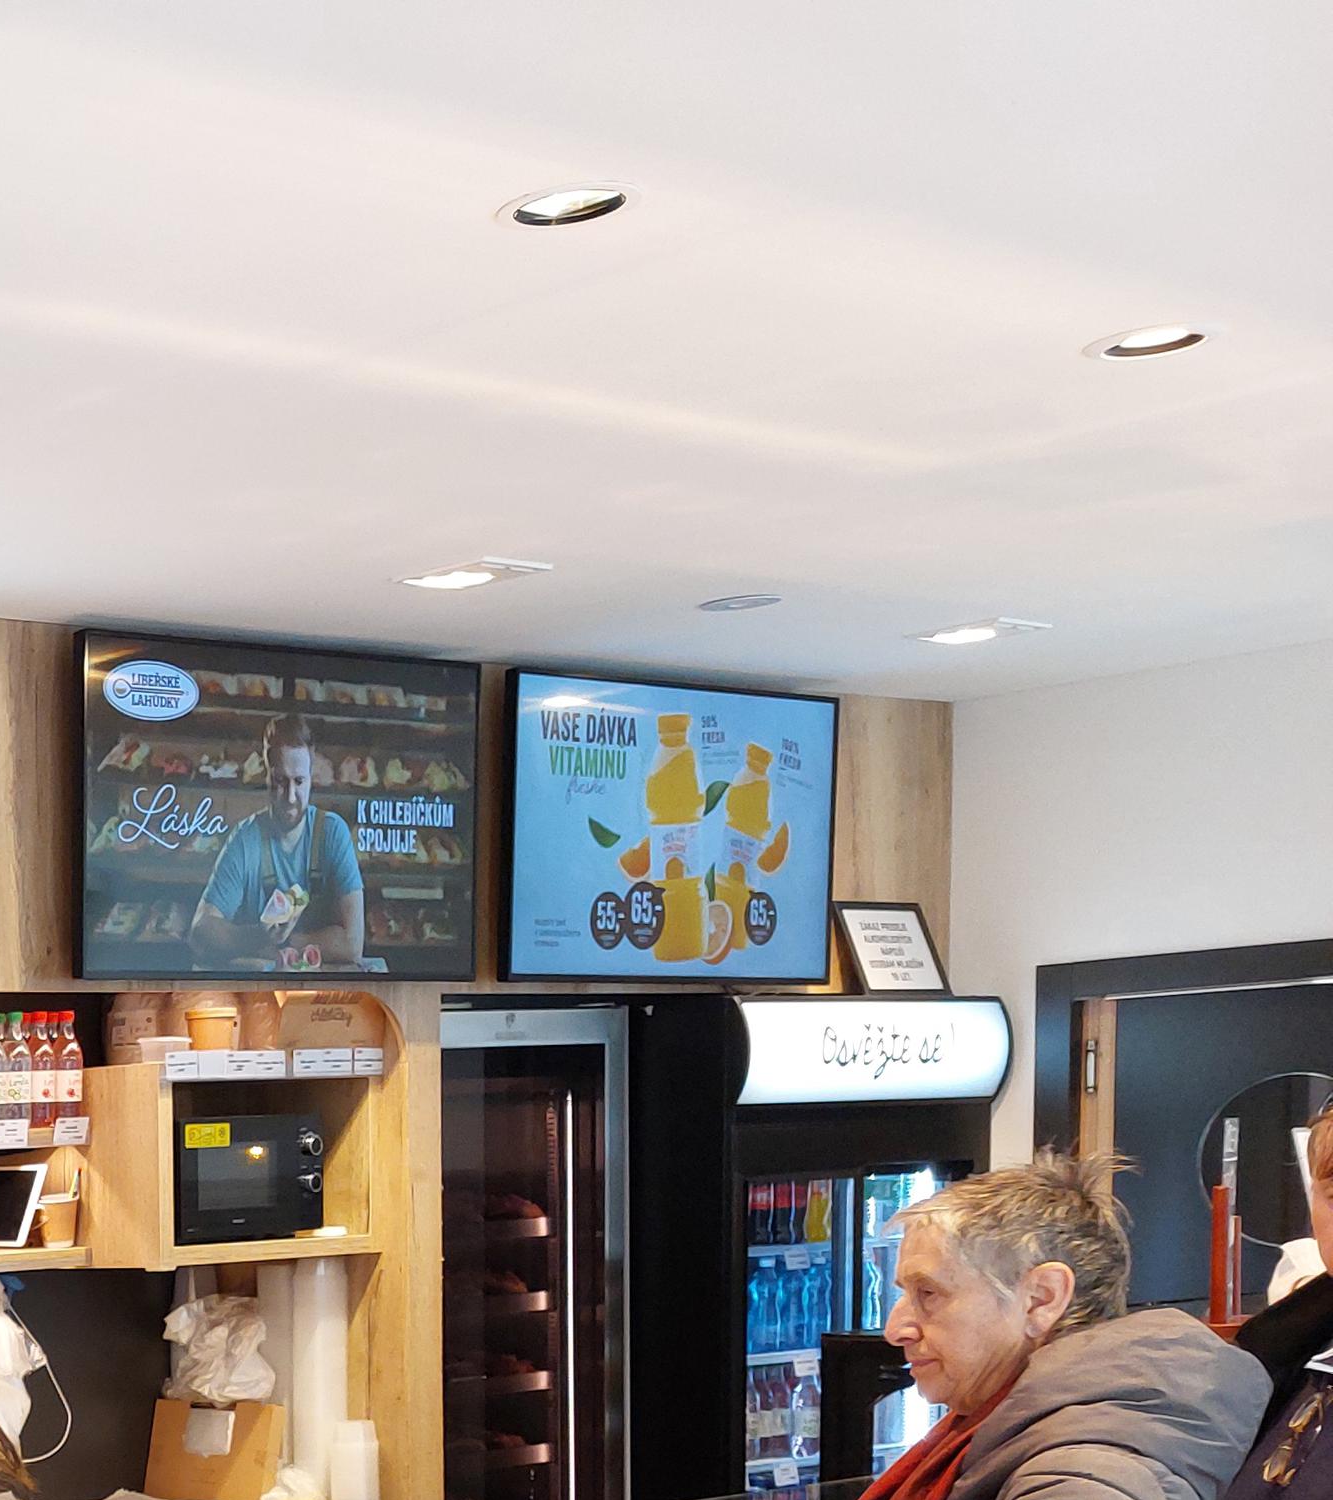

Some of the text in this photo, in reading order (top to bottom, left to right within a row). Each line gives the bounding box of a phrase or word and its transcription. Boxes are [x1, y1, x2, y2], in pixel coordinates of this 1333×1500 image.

[131, 672, 181, 688] LIBEŘSKÉ
[131, 693, 181, 709] LAHŮDKY
[586, 707, 637, 747] DÁVKA
[118, 784, 229, 849] Láska
[358, 796, 454, 828] K CHLEBÍČKŮM
[358, 829, 418, 855] SPOJUJE
[631, 891, 662, 928] 65,-
[822, 1023, 911, 1080] Osvěžte
